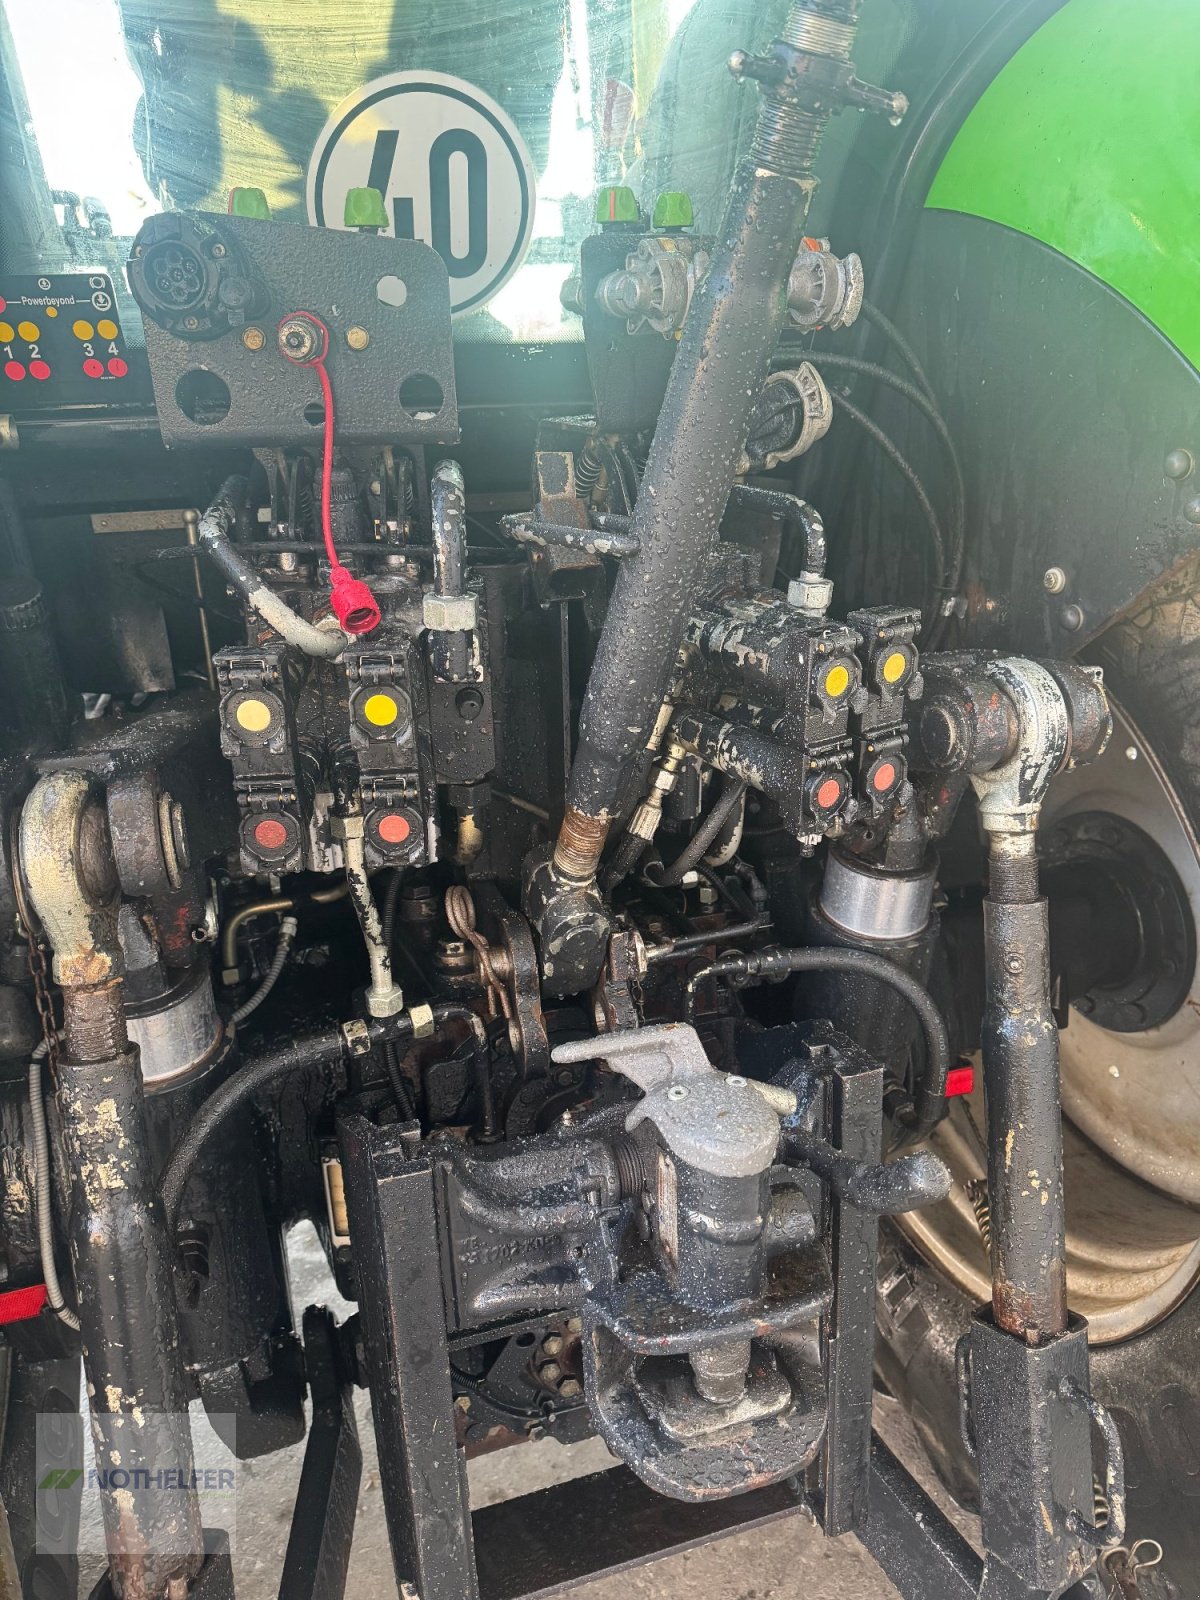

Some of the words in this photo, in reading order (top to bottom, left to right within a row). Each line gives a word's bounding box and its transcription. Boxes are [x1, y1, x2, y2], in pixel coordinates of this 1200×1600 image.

[21, 295, 75, 307] Powerbeyond
[4, 345, 13, 359] 1
[29, 344, 41, 358] 2
[83, 343, 94, 356] 3
[108, 342, 118, 355] 4
